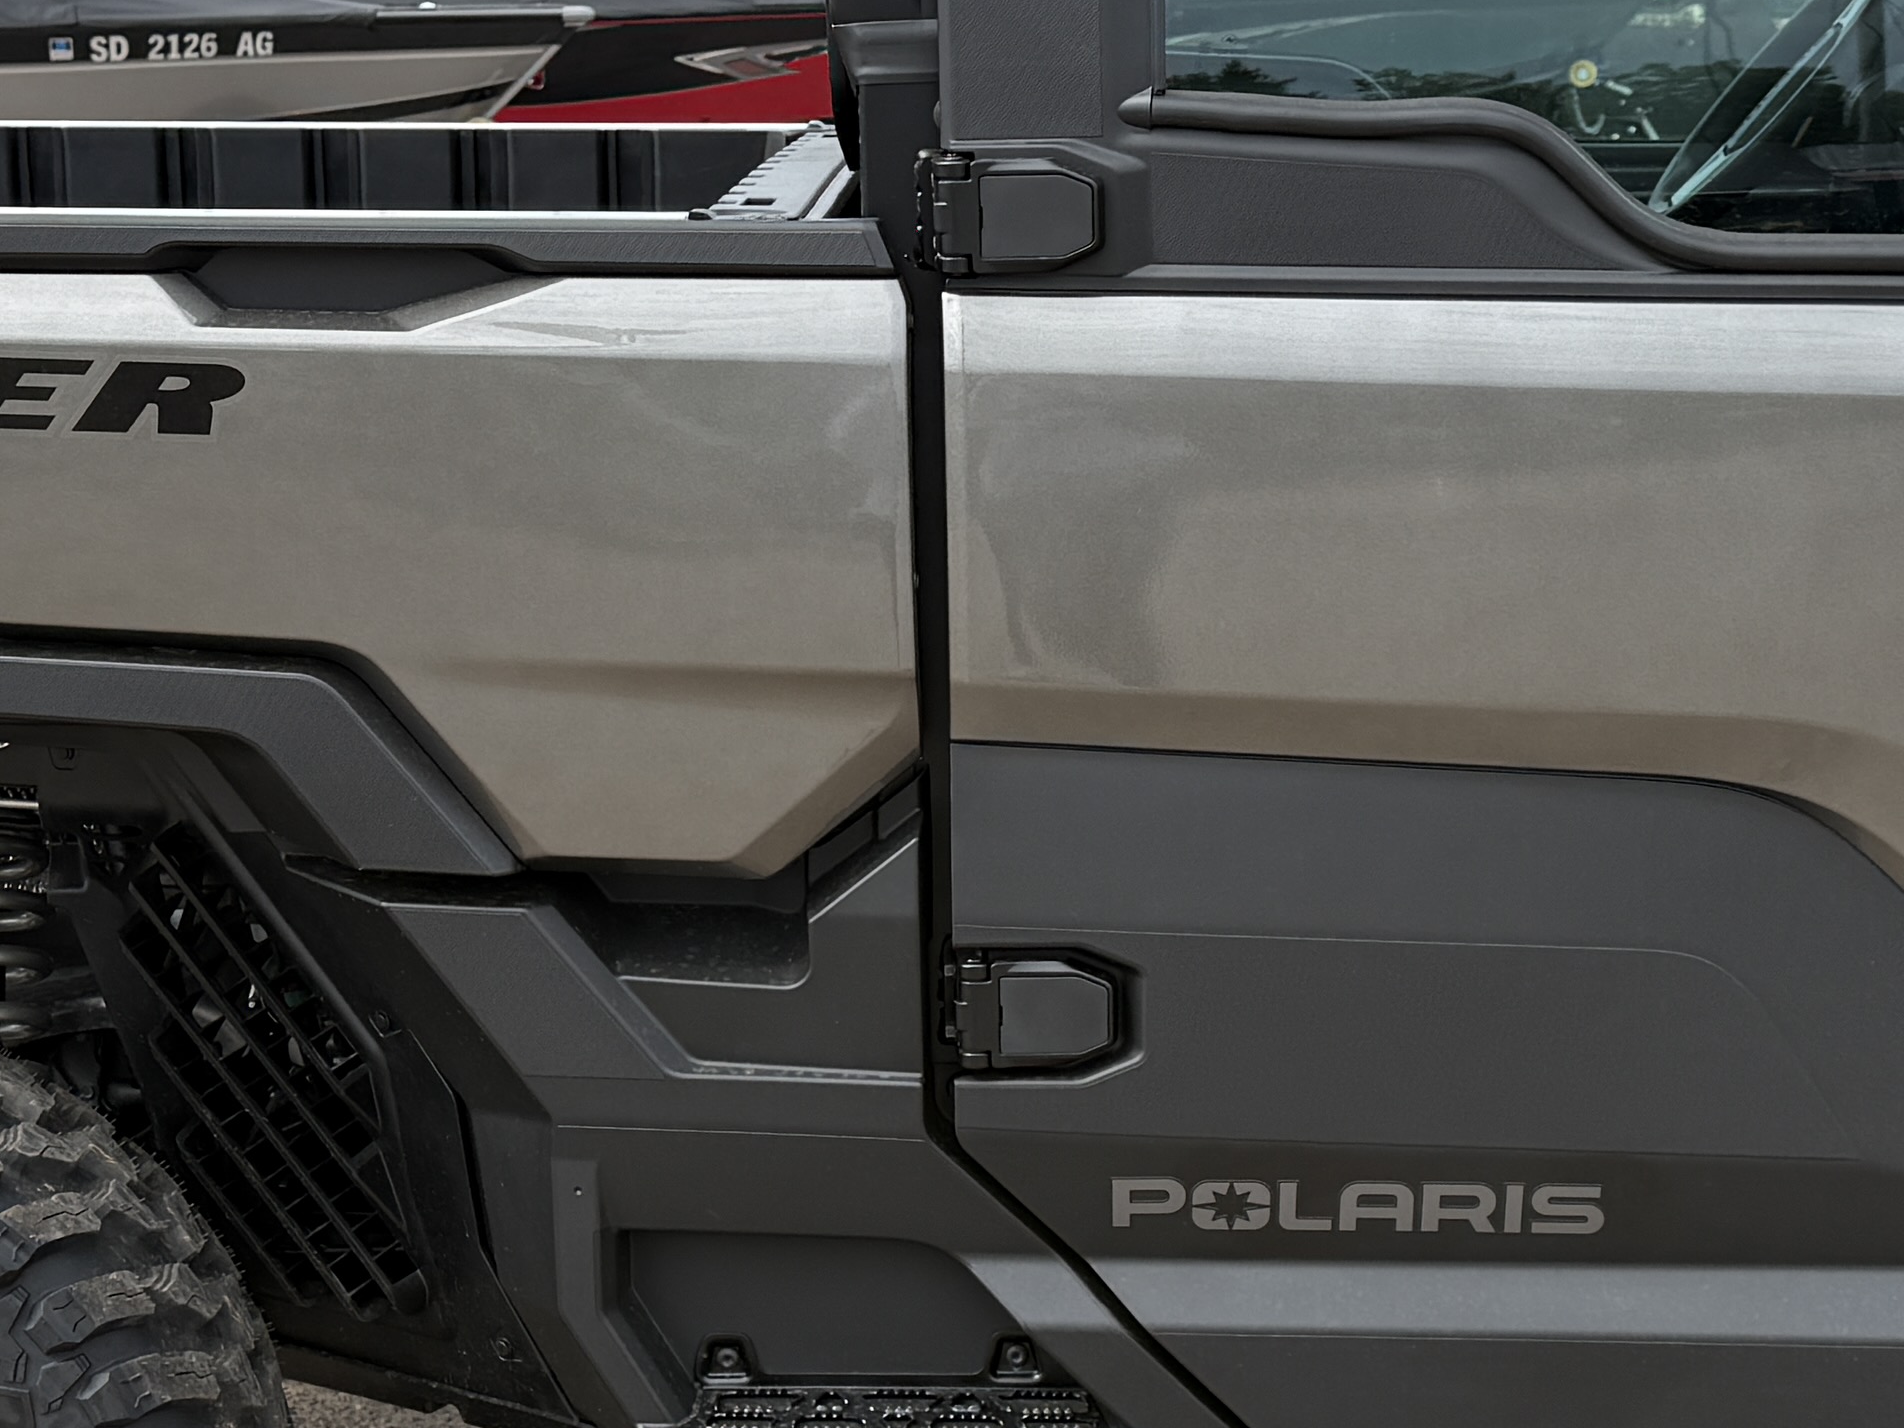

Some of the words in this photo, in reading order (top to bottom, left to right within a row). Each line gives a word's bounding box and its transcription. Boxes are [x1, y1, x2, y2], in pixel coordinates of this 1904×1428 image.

[89, 34, 130, 62] SD
[147, 32, 218, 61] 2126
[235, 30, 274, 57] AG
[1109, 1177, 1607, 1235] POLARIS
